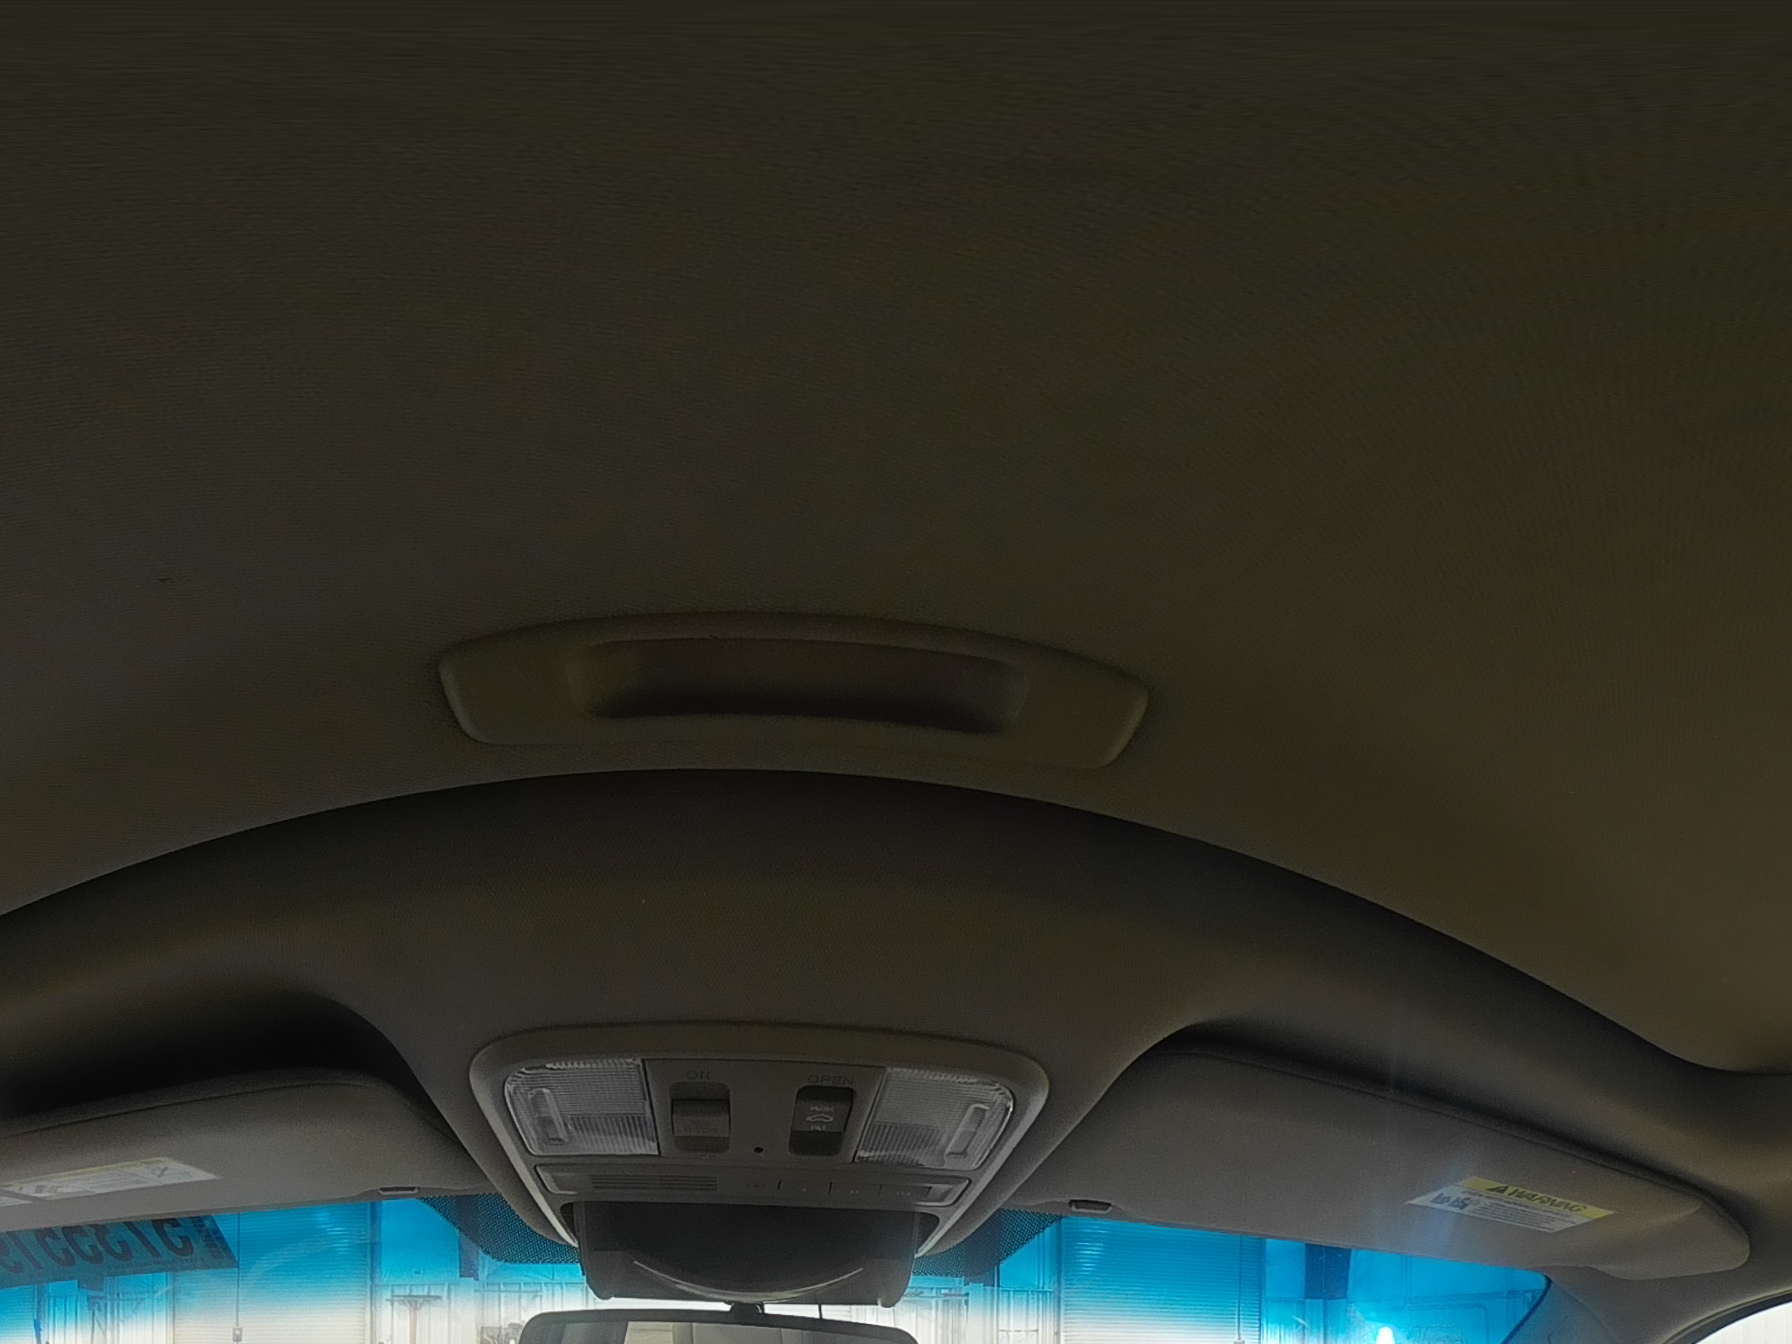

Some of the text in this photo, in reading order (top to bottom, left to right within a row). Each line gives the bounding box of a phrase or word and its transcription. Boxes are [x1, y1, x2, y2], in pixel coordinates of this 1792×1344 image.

[686, 1070, 710, 1081] ON
[807, 1074, 855, 1086] OPEN
[1507, 1188, 1588, 1212] WARNING
